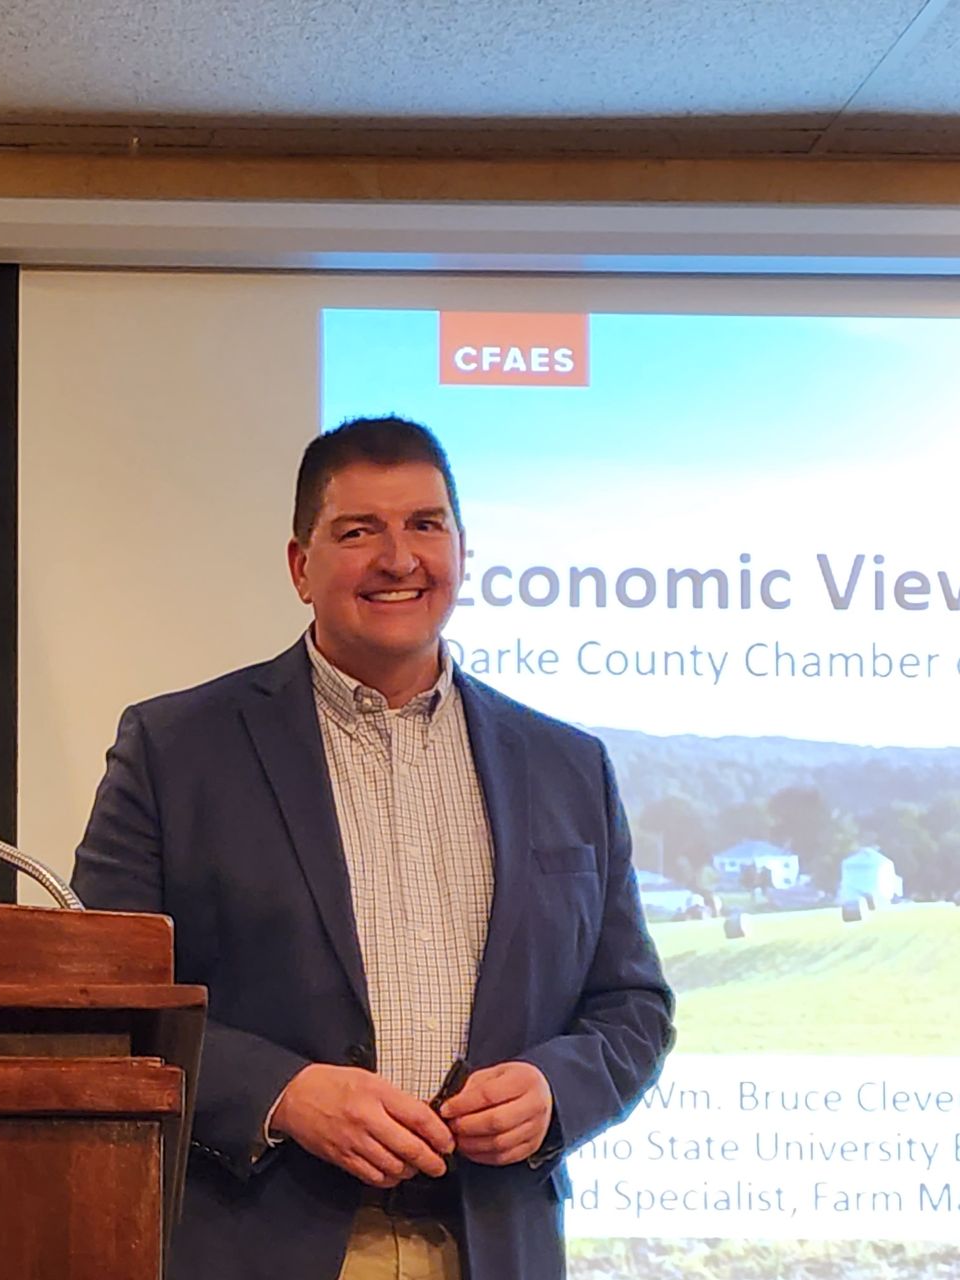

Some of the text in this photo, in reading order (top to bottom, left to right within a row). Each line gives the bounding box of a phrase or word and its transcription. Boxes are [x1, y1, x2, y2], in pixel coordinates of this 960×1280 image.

[453, 346, 575, 373] CFAES
[456, 549, 792, 610] conomic
[576, 640, 729, 686] County
[744, 640, 940, 679] Chamber
[642, 1080, 721, 1110] Wm.
[739, 1081, 842, 1112] Bruce
[647, 1130, 739, 1161] State
[756, 1132, 939, 1171] University
[614, 1180, 797, 1218] Specialist,
[814, 1181, 903, 1212] Farm
